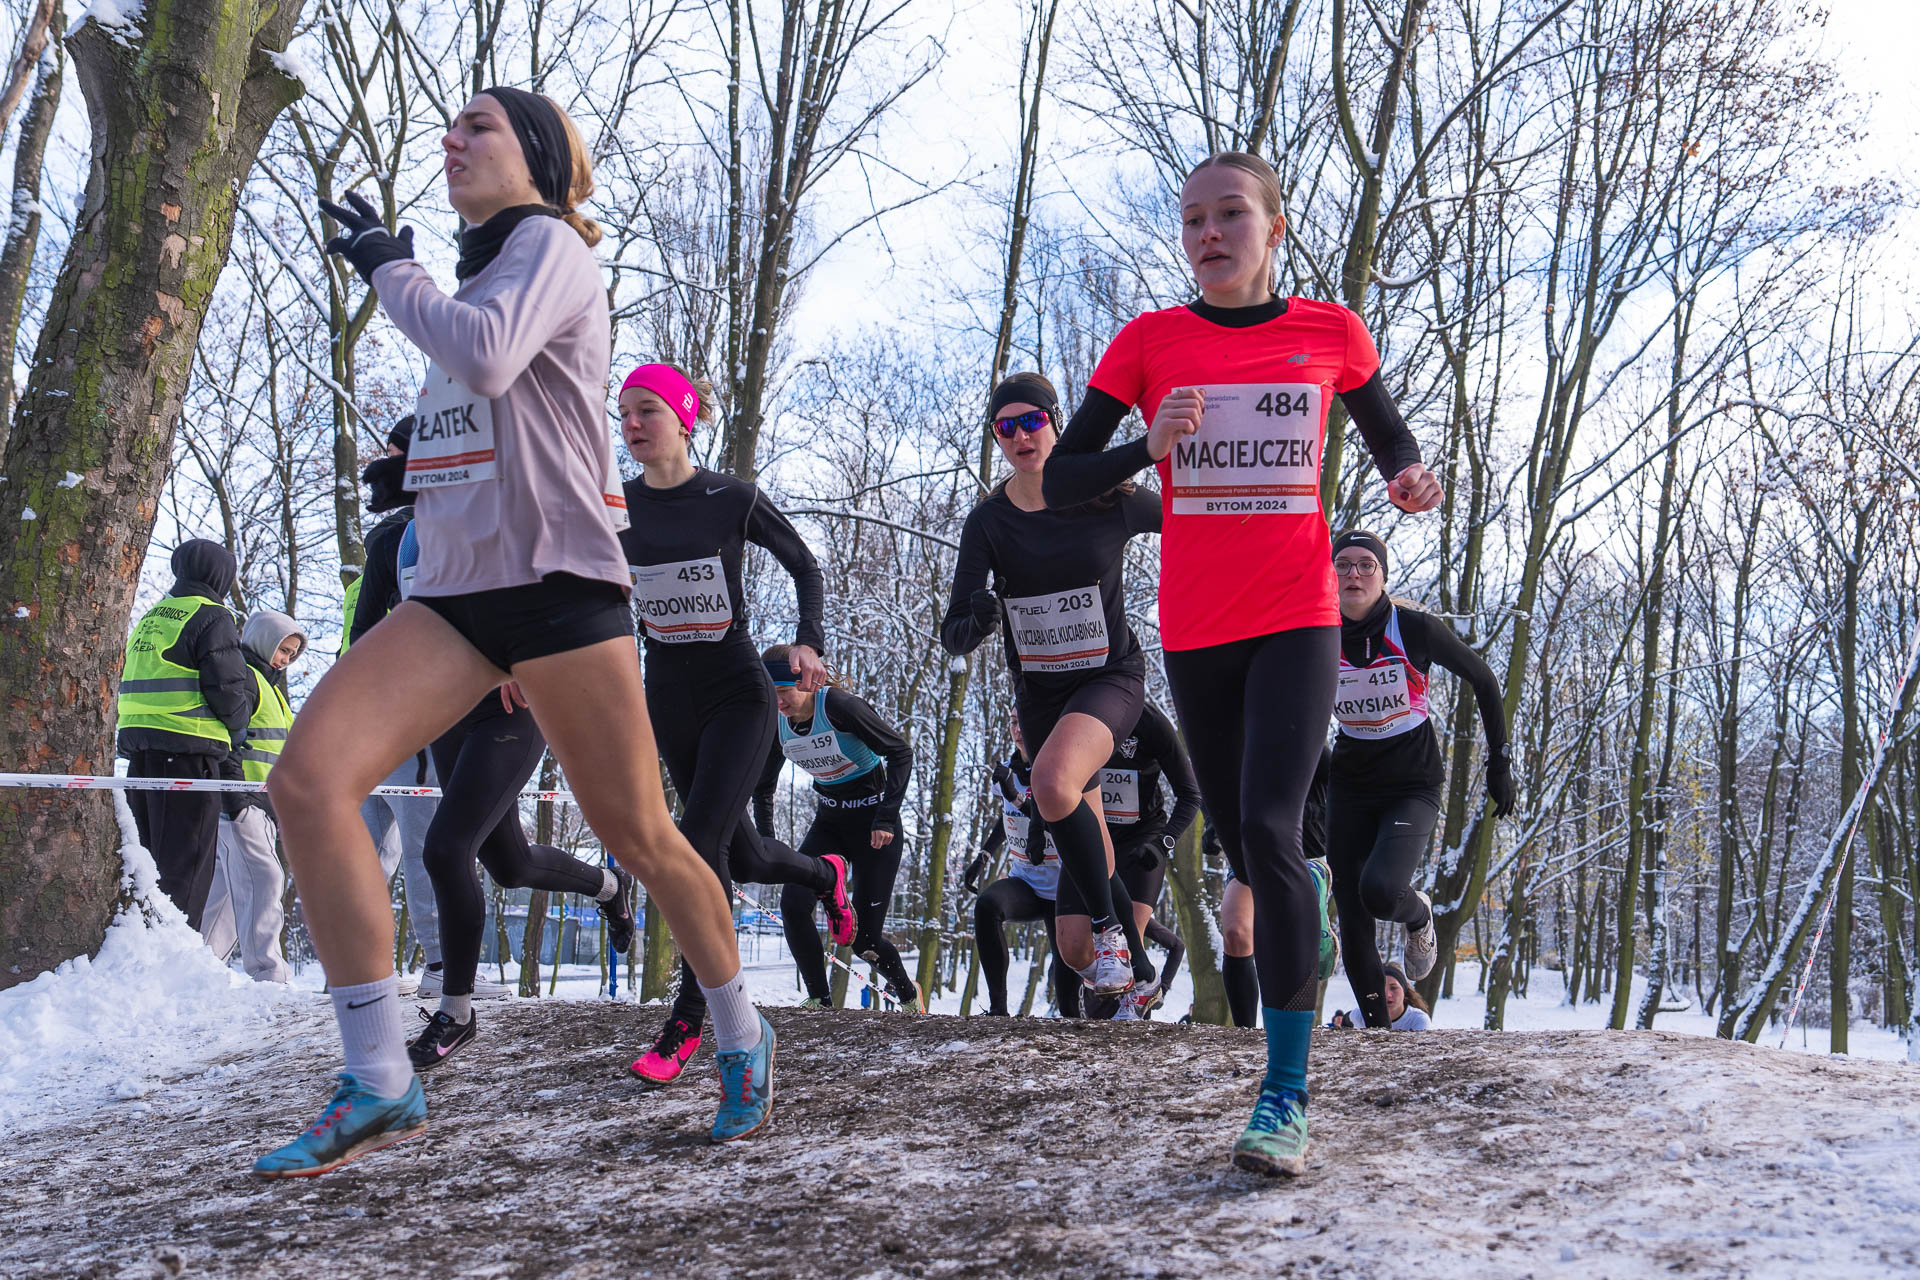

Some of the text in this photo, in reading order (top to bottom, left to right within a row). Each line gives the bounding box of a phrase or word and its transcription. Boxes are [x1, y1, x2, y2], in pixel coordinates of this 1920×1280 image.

[1288, 354, 1310, 364] 4F
[1255, 392, 1309, 417] 484
[1177, 439, 1314, 468] MACIEJCZEK
[411, 469, 470, 485] BYTOM 2024
[1206, 500, 1288, 511] BYTOM 2024
[677, 564, 715, 583] 453
[1057, 592, 1093, 613] 203
[1019, 605, 1048, 616] FUEL
[692, 632, 712, 640] 2024
[1016, 629, 1048, 647] KUCZABA
[1046, 628, 1060, 646] VEL
[1070, 659, 1091, 669] 2024
[1369, 669, 1398, 686] 415
[1334, 693, 1406, 715] KRYSIAK
[1378, 722, 1394, 733] 2024
[811, 735, 833, 750] 159
[795, 753, 846, 769] OBOLEWSKA
[1106, 772, 1132, 785] 204
[841, 794, 878, 809] NIKE
